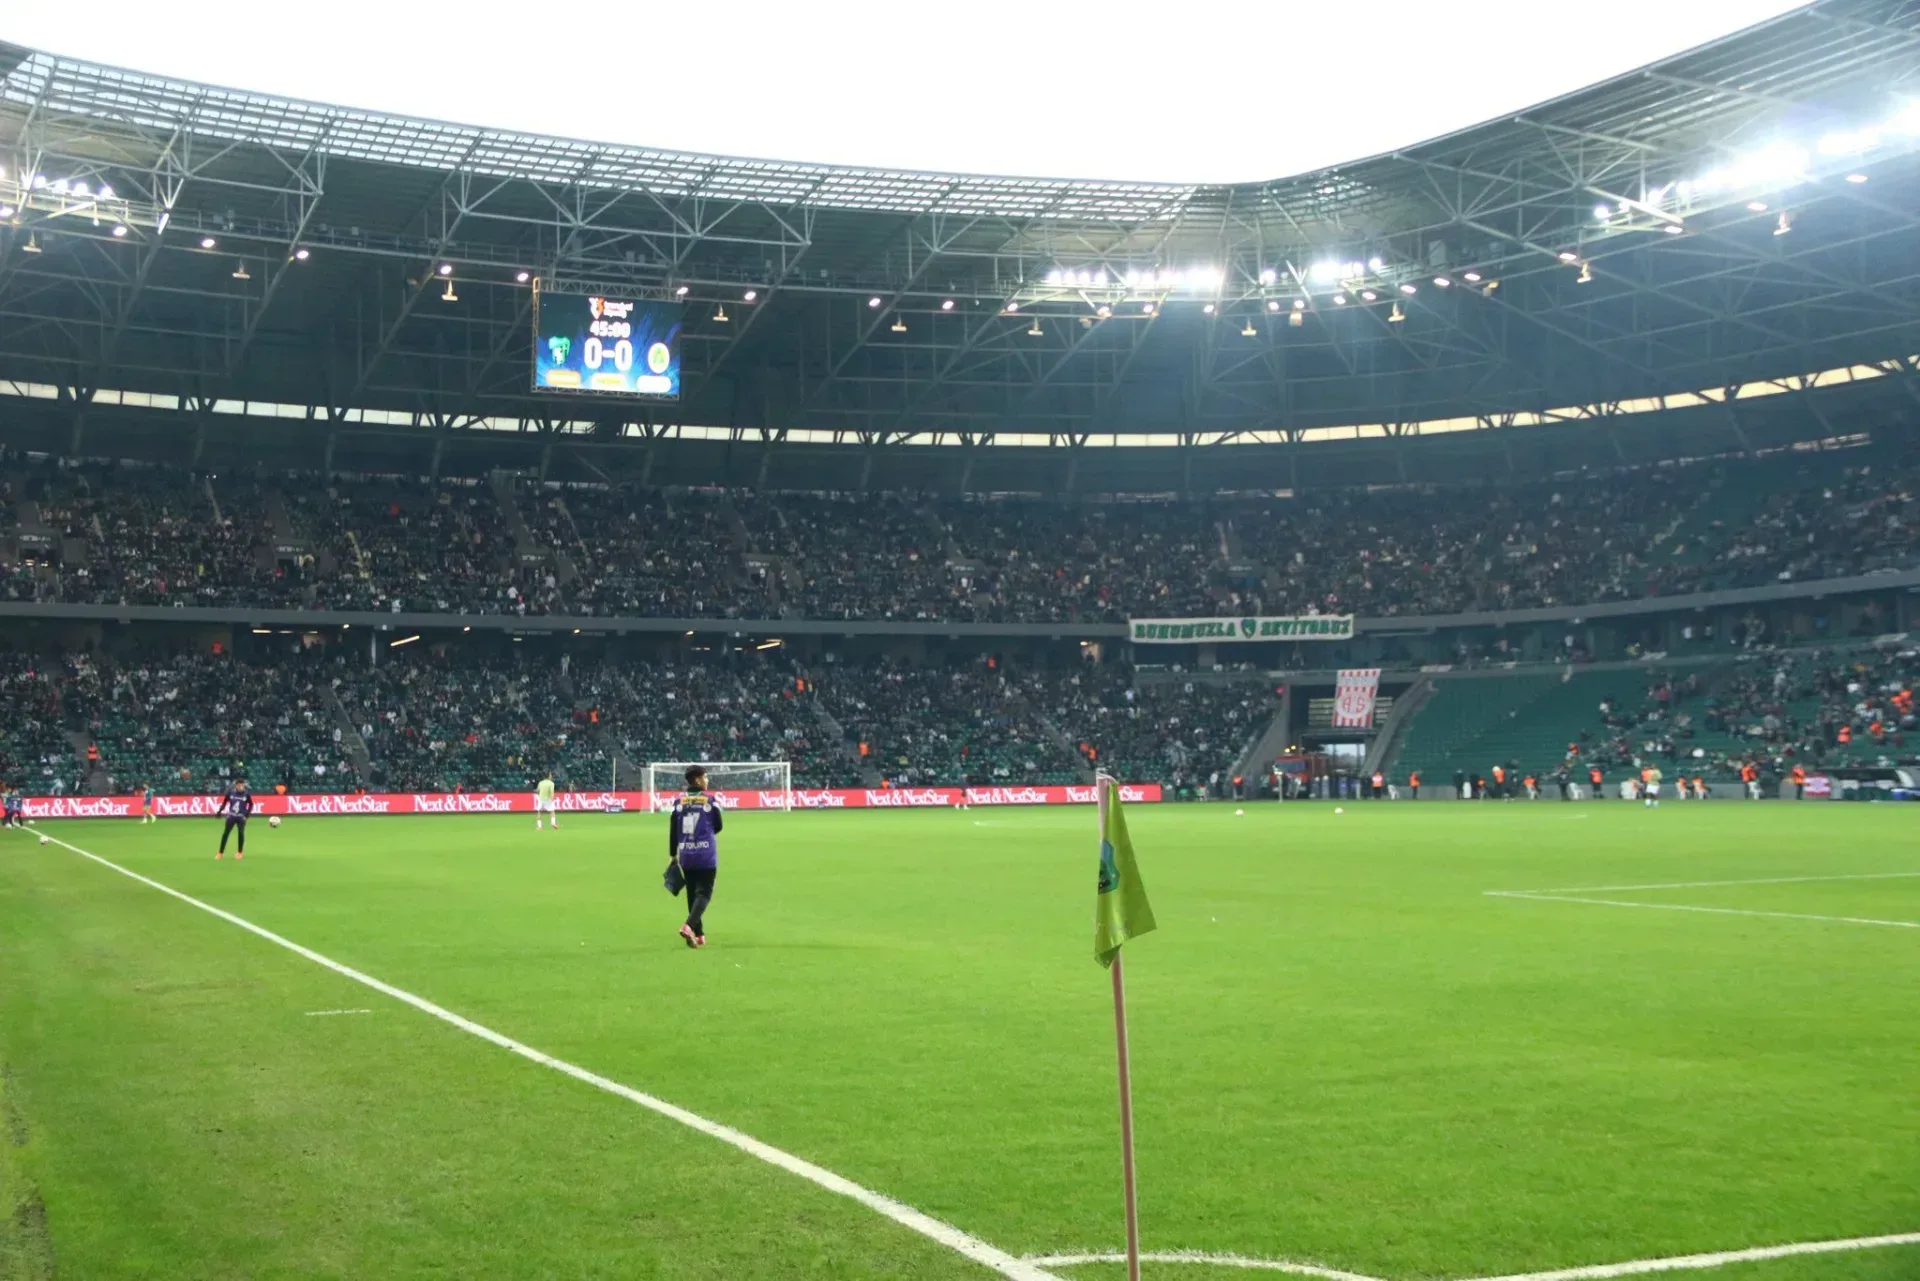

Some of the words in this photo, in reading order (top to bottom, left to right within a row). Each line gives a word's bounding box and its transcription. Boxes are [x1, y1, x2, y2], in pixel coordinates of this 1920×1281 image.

[413, 794, 443, 812] Next
[444, 794, 457, 811] &
[458, 794, 511, 812] NextStar
[562, 793, 574, 810] &
[575, 793, 626, 809] NextStar
[759, 791, 784, 807] Next
[797, 790, 845, 807] NextStar
[865, 789, 890, 806] Next
[891, 789, 903, 805] &
[903, 789, 949, 805] NextStar
[966, 788, 990, 804] Next
[991, 788, 1002, 804] &
[1002, 787, 1047, 803] NextStar
[1066, 786, 1089, 803] Next
[51, 798, 66, 816] &
[67, 797, 130, 816] NextStar
[157, 797, 189, 815] Next
[190, 797, 203, 814] &
[287, 795, 318, 814] Next
[319, 796, 331, 813] &
[333, 795, 389, 813] NextStar
